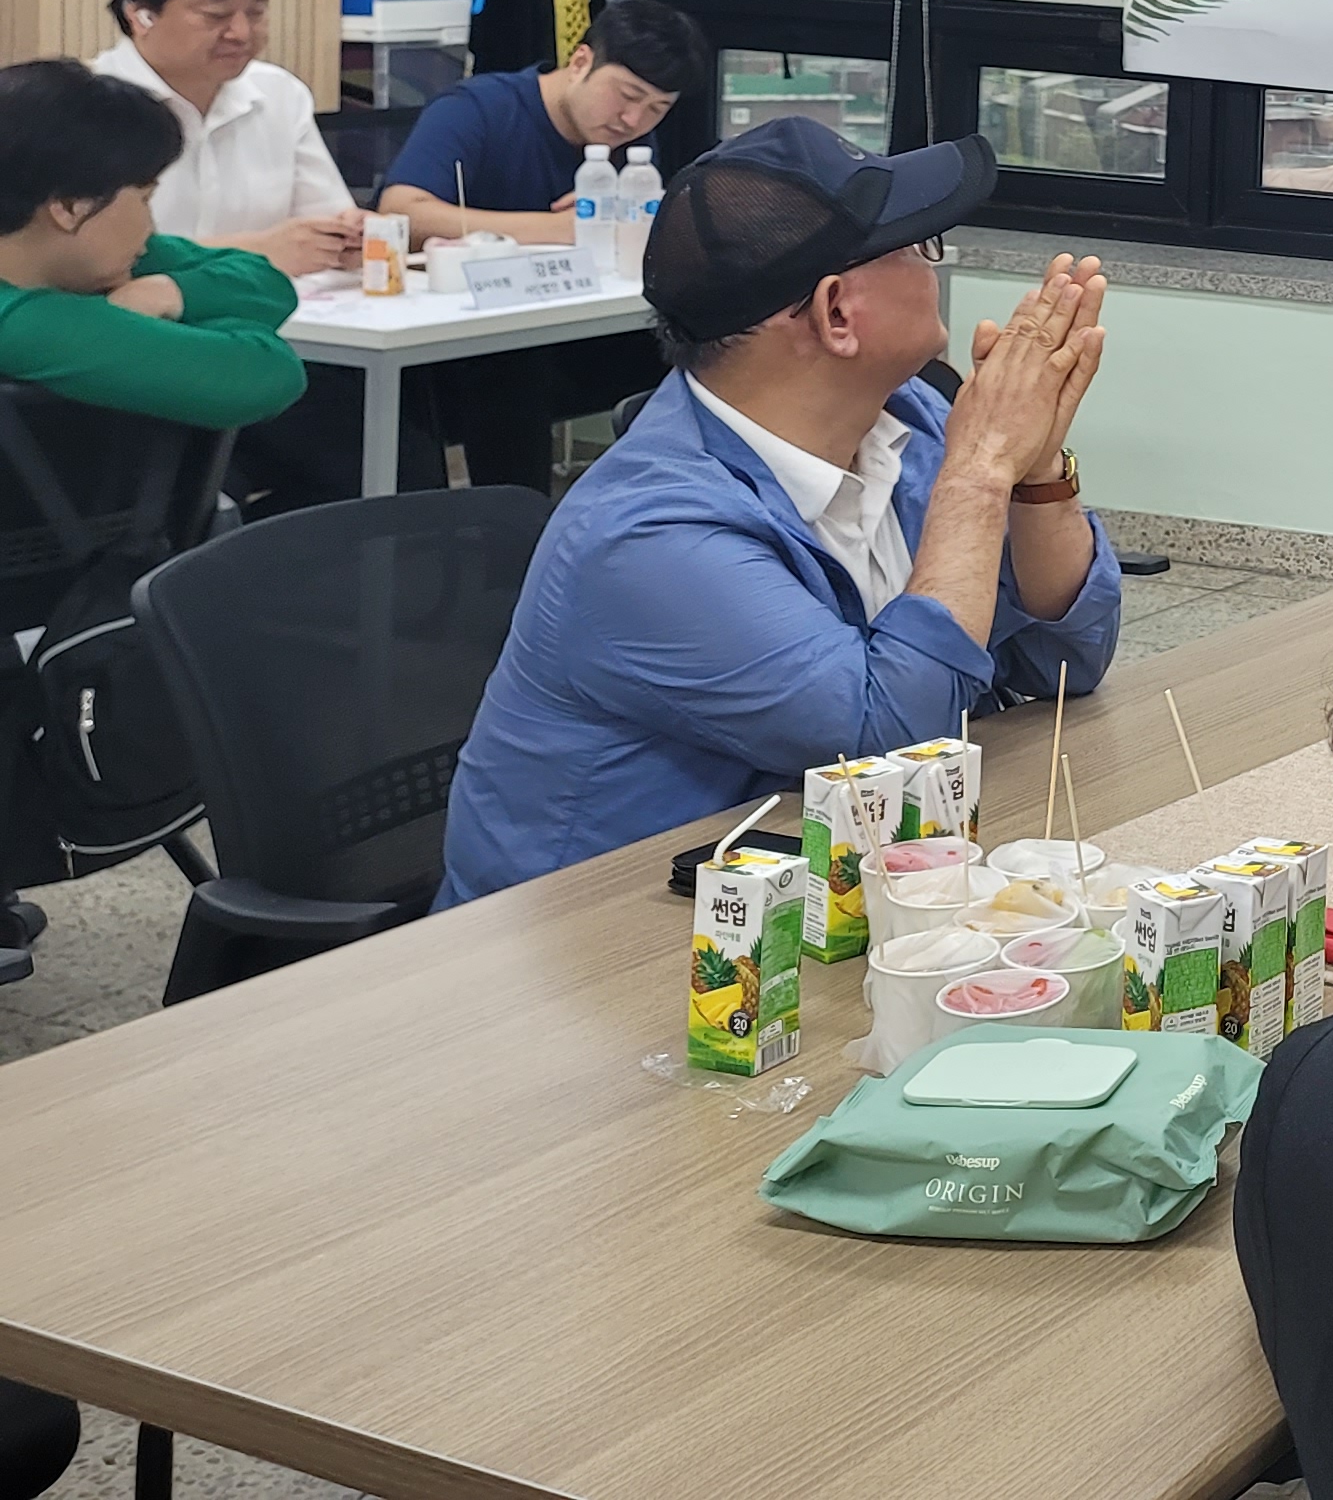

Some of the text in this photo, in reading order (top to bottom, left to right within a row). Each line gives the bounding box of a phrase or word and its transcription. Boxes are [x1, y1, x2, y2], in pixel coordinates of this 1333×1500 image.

[711, 897, 748, 927] 썬업
[1134, 920, 1157, 953] 썬업
[733, 1018, 748, 1031] 20
[1224, 1021, 1238, 1035] 20
[925, 1177, 1025, 1205] ORIGIN
